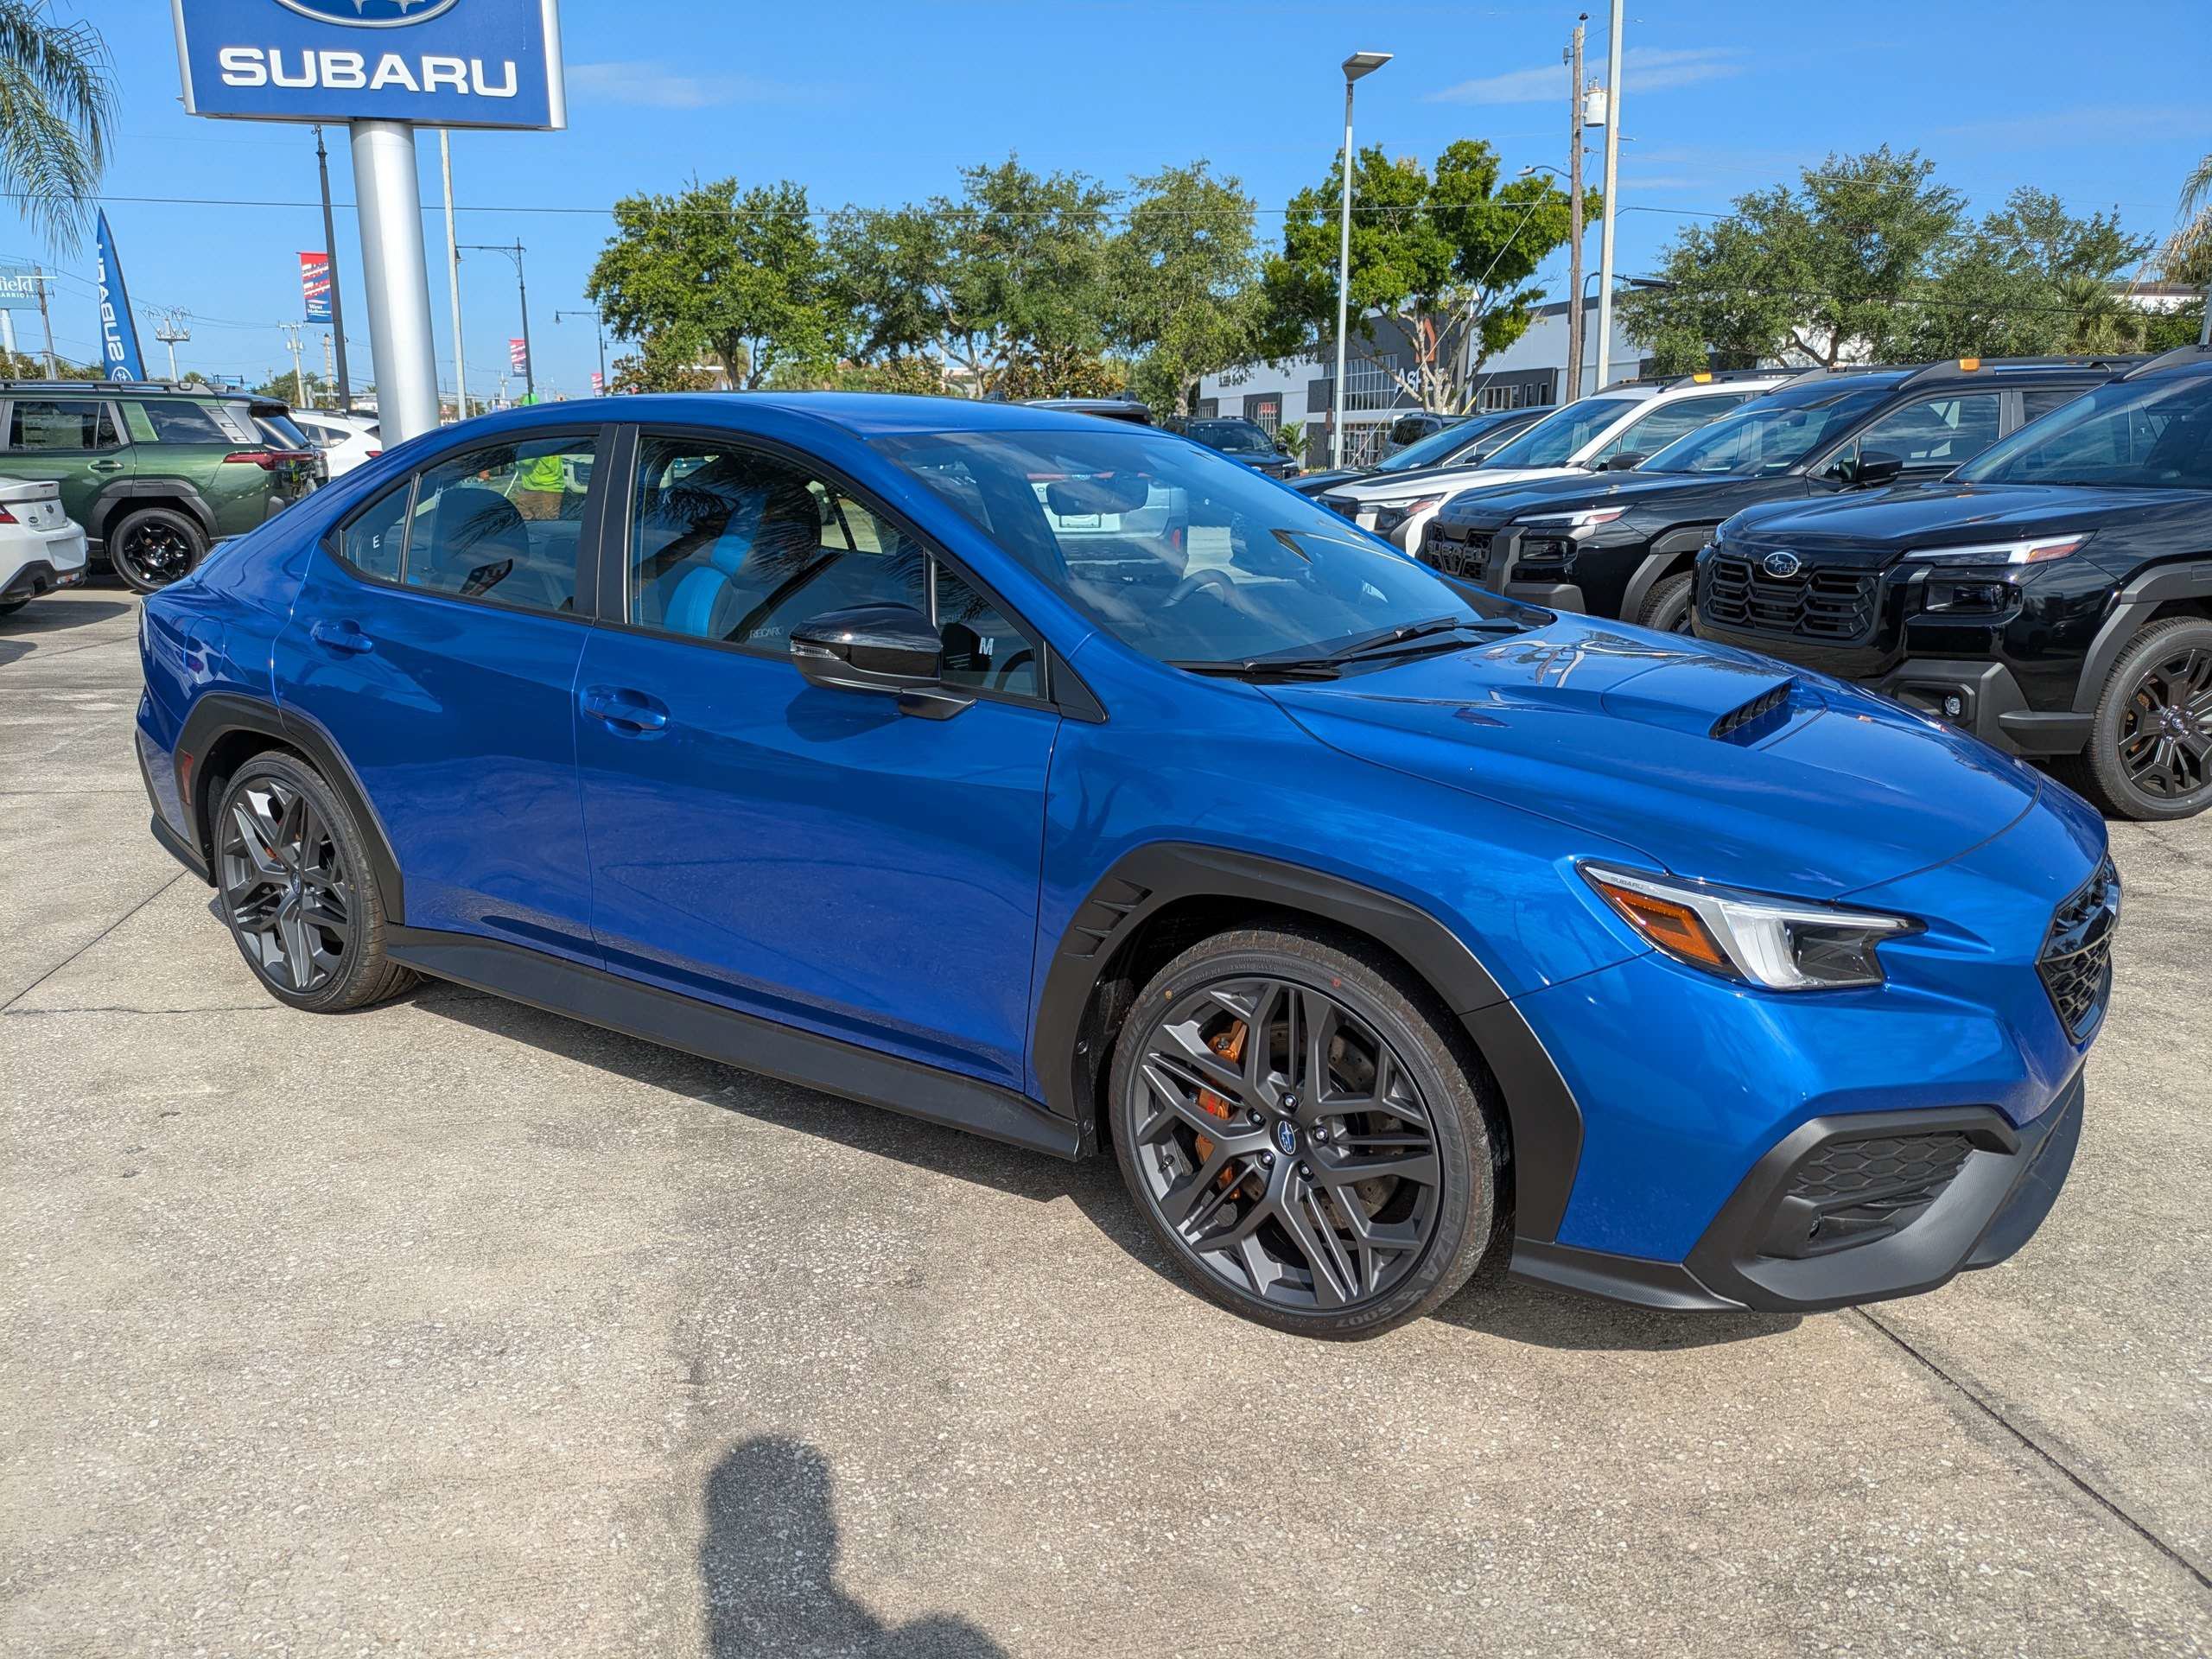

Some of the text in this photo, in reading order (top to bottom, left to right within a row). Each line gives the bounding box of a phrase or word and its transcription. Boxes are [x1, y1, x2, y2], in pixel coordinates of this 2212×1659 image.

[219, 48, 518, 98] SUBARU
[372, 535, 380, 549] E
[978, 637, 995, 656] M
